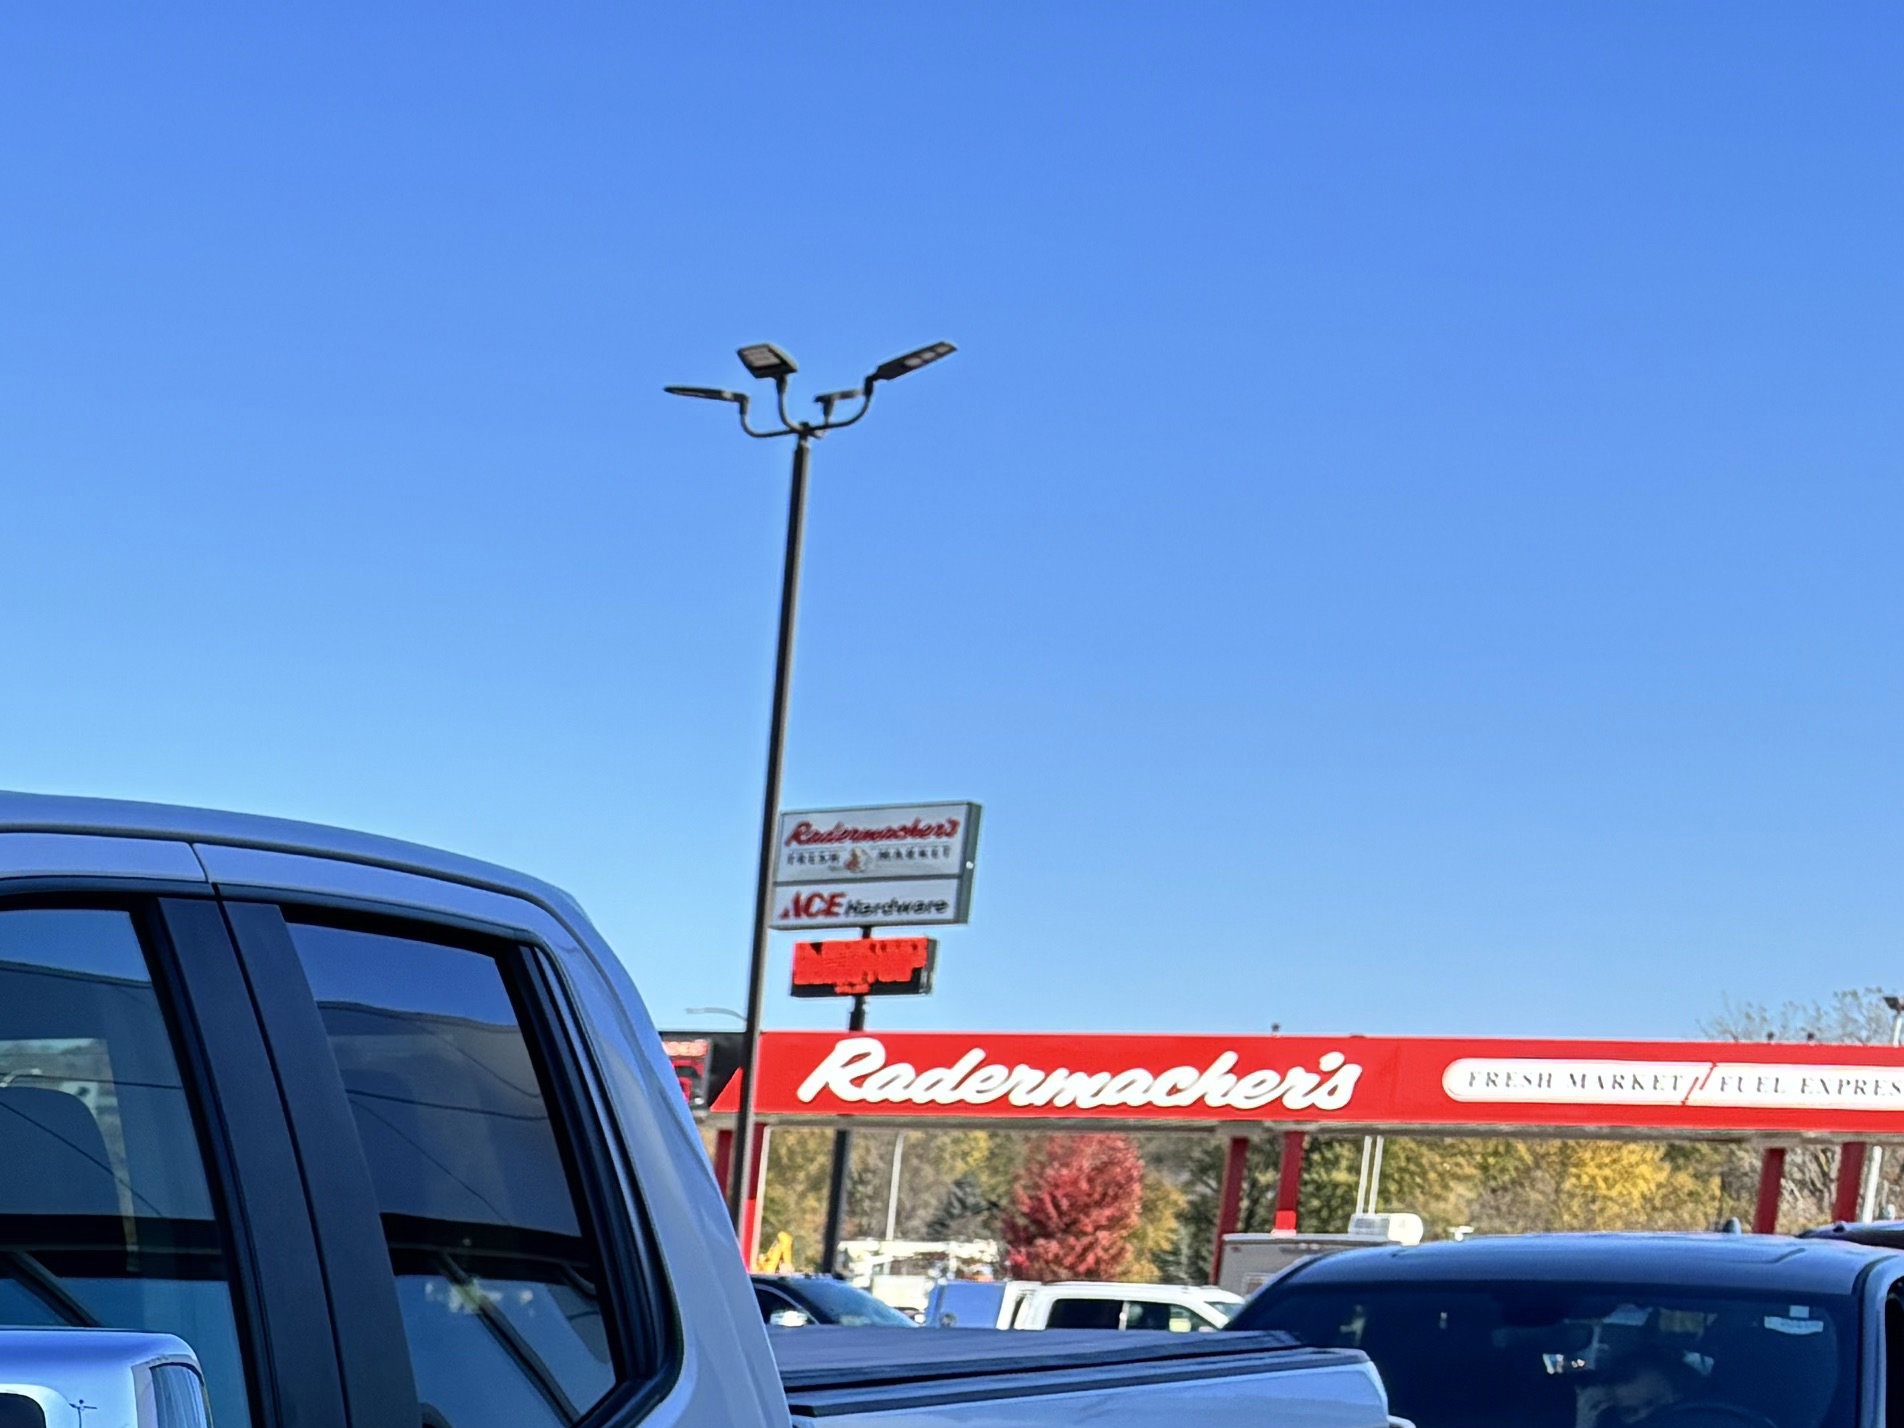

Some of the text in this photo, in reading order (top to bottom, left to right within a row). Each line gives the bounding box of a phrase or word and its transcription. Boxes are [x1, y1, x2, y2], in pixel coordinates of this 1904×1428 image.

[785, 817, 961, 847] Radermacher's
[779, 891, 949, 920] ACE Hardware
[797, 1037, 1363, 1111] Radermacher's
[1468, 1071, 1685, 1091] FRESH MARKET
[1720, 1075, 1785, 1094] FUEL
